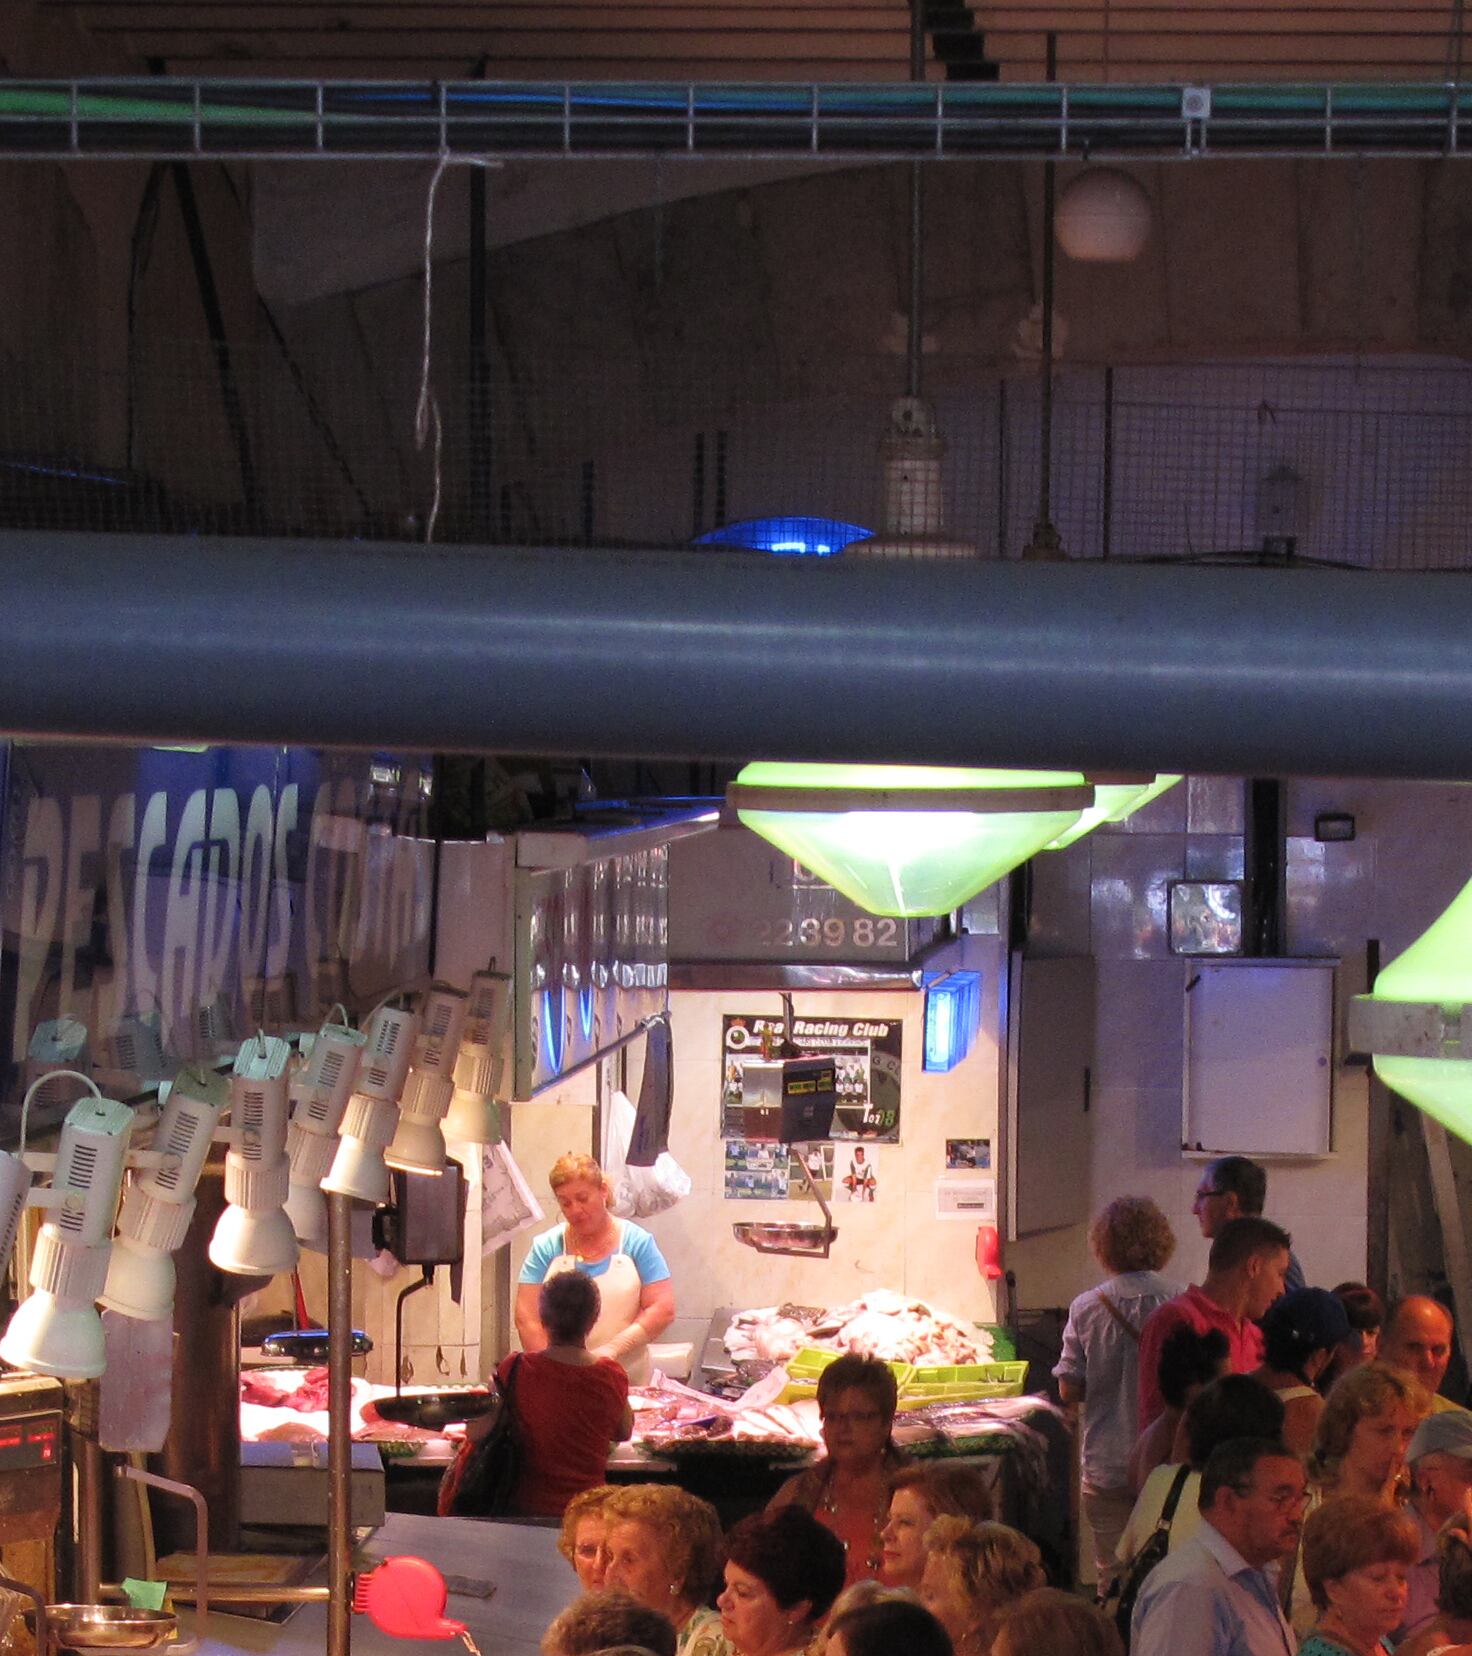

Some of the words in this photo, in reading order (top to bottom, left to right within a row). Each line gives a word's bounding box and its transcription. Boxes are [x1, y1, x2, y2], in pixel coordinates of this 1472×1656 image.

[853, 918, 898, 947] 82
[793, 1020, 849, 1037] Racing
[852, 1022, 889, 1038] Club
